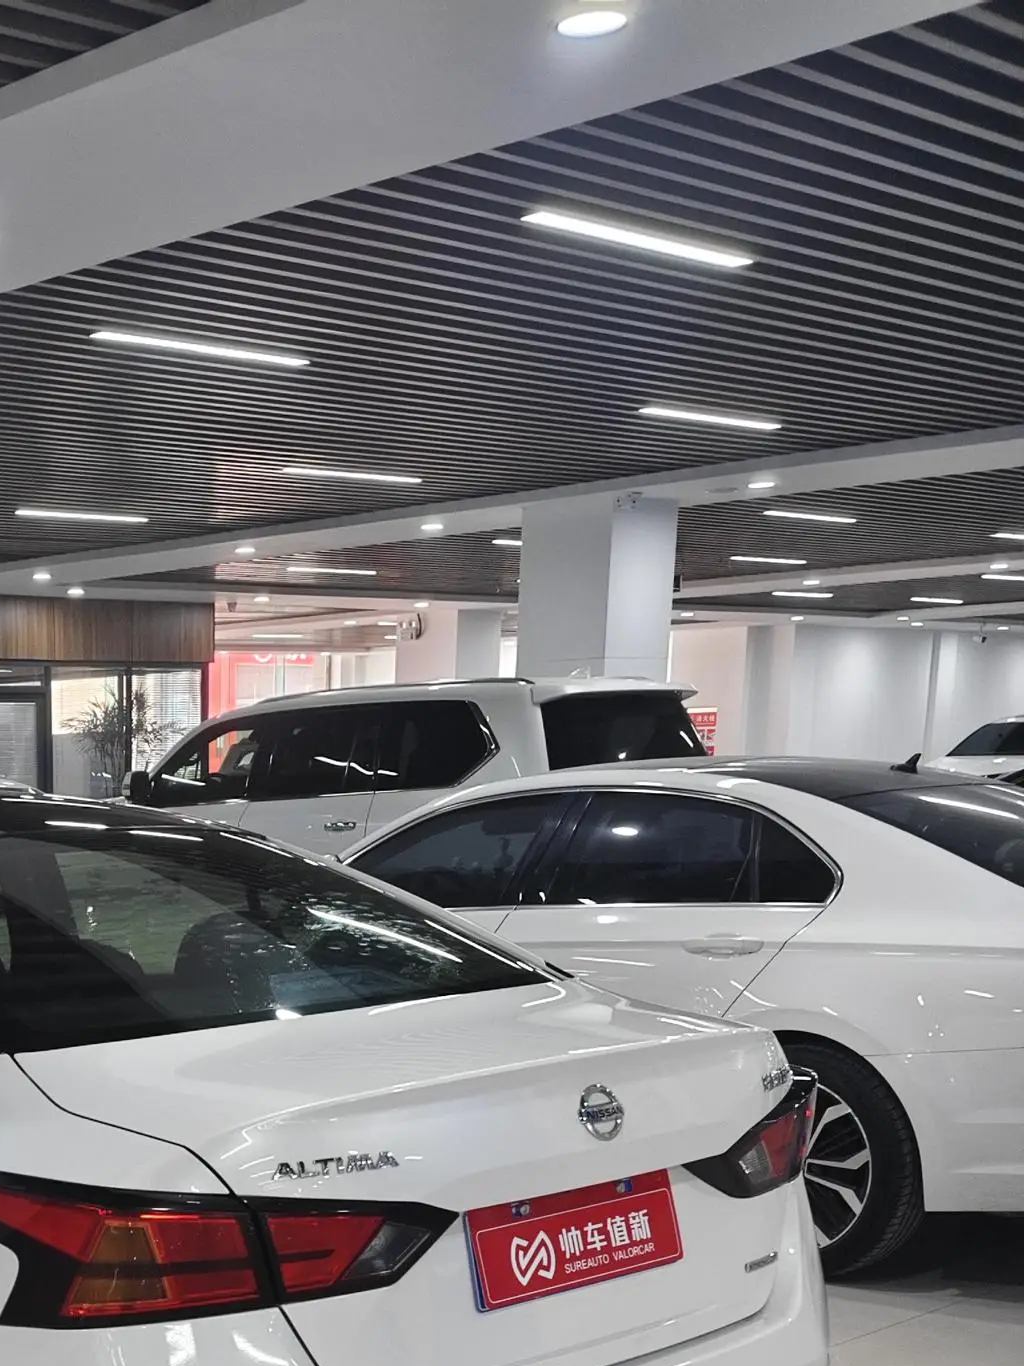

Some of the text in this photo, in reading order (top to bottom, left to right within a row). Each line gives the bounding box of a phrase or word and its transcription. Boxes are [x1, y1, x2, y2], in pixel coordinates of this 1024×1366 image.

[586, 1104, 624, 1120] NISSAN
[271, 1151, 400, 1181] ALTIMA
[558, 1210, 652, 1259] 帅车值新
[564, 1243, 655, 1274] SUREAUTO VALORCAR
